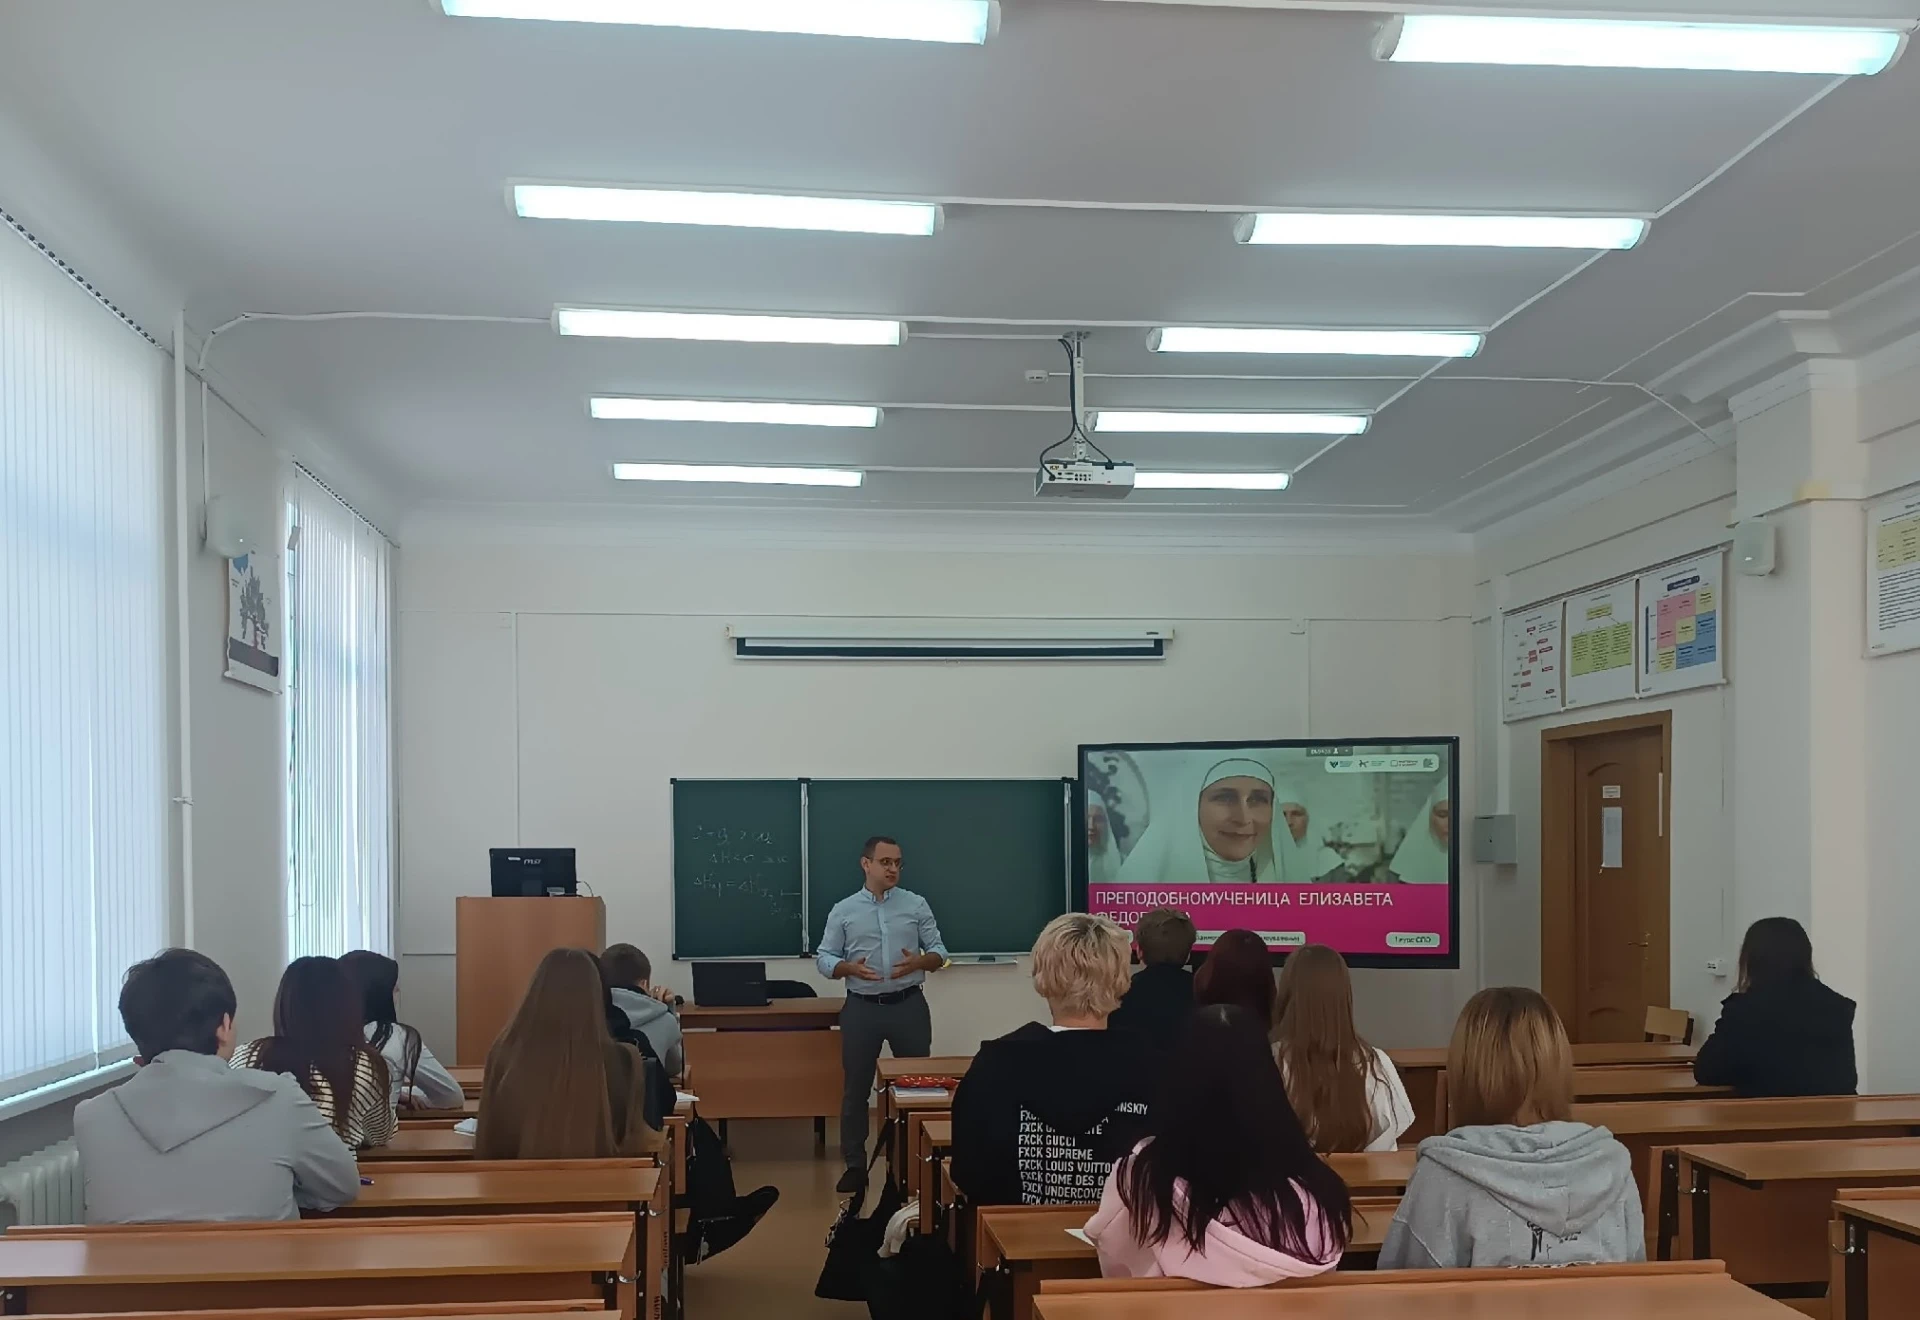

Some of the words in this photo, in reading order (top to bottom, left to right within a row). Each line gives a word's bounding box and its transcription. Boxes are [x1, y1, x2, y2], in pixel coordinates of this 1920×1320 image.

[1096, 890, 1290, 908] ПРЕПОДОБНОМУЧЕНИЦА
[1299, 891, 1393, 906] ЕЛИЗАВЕТА
[1020, 1109, 1040, 1121] FXC
[1019, 1122, 1044, 1133] FXCK
[1018, 1134, 1043, 1145] FXCK
[1045, 1134, 1076, 1147] GUCCI
[1018, 1146, 1043, 1158] FXCK
[1045, 1147, 1093, 1160] SUPREME
[1018, 1159, 1043, 1171] FXCK
[1045, 1160, 1074, 1172] LOUIS
[1077, 1162, 1112, 1174] VUITTO
[1020, 1171, 1044, 1182] FXCK
[1045, 1172, 1073, 1185] COME
[1075, 1174, 1095, 1186] DES
[1022, 1181, 1043, 1195] FXCK
[1045, 1185, 1103, 1199] UNDERCOVE
